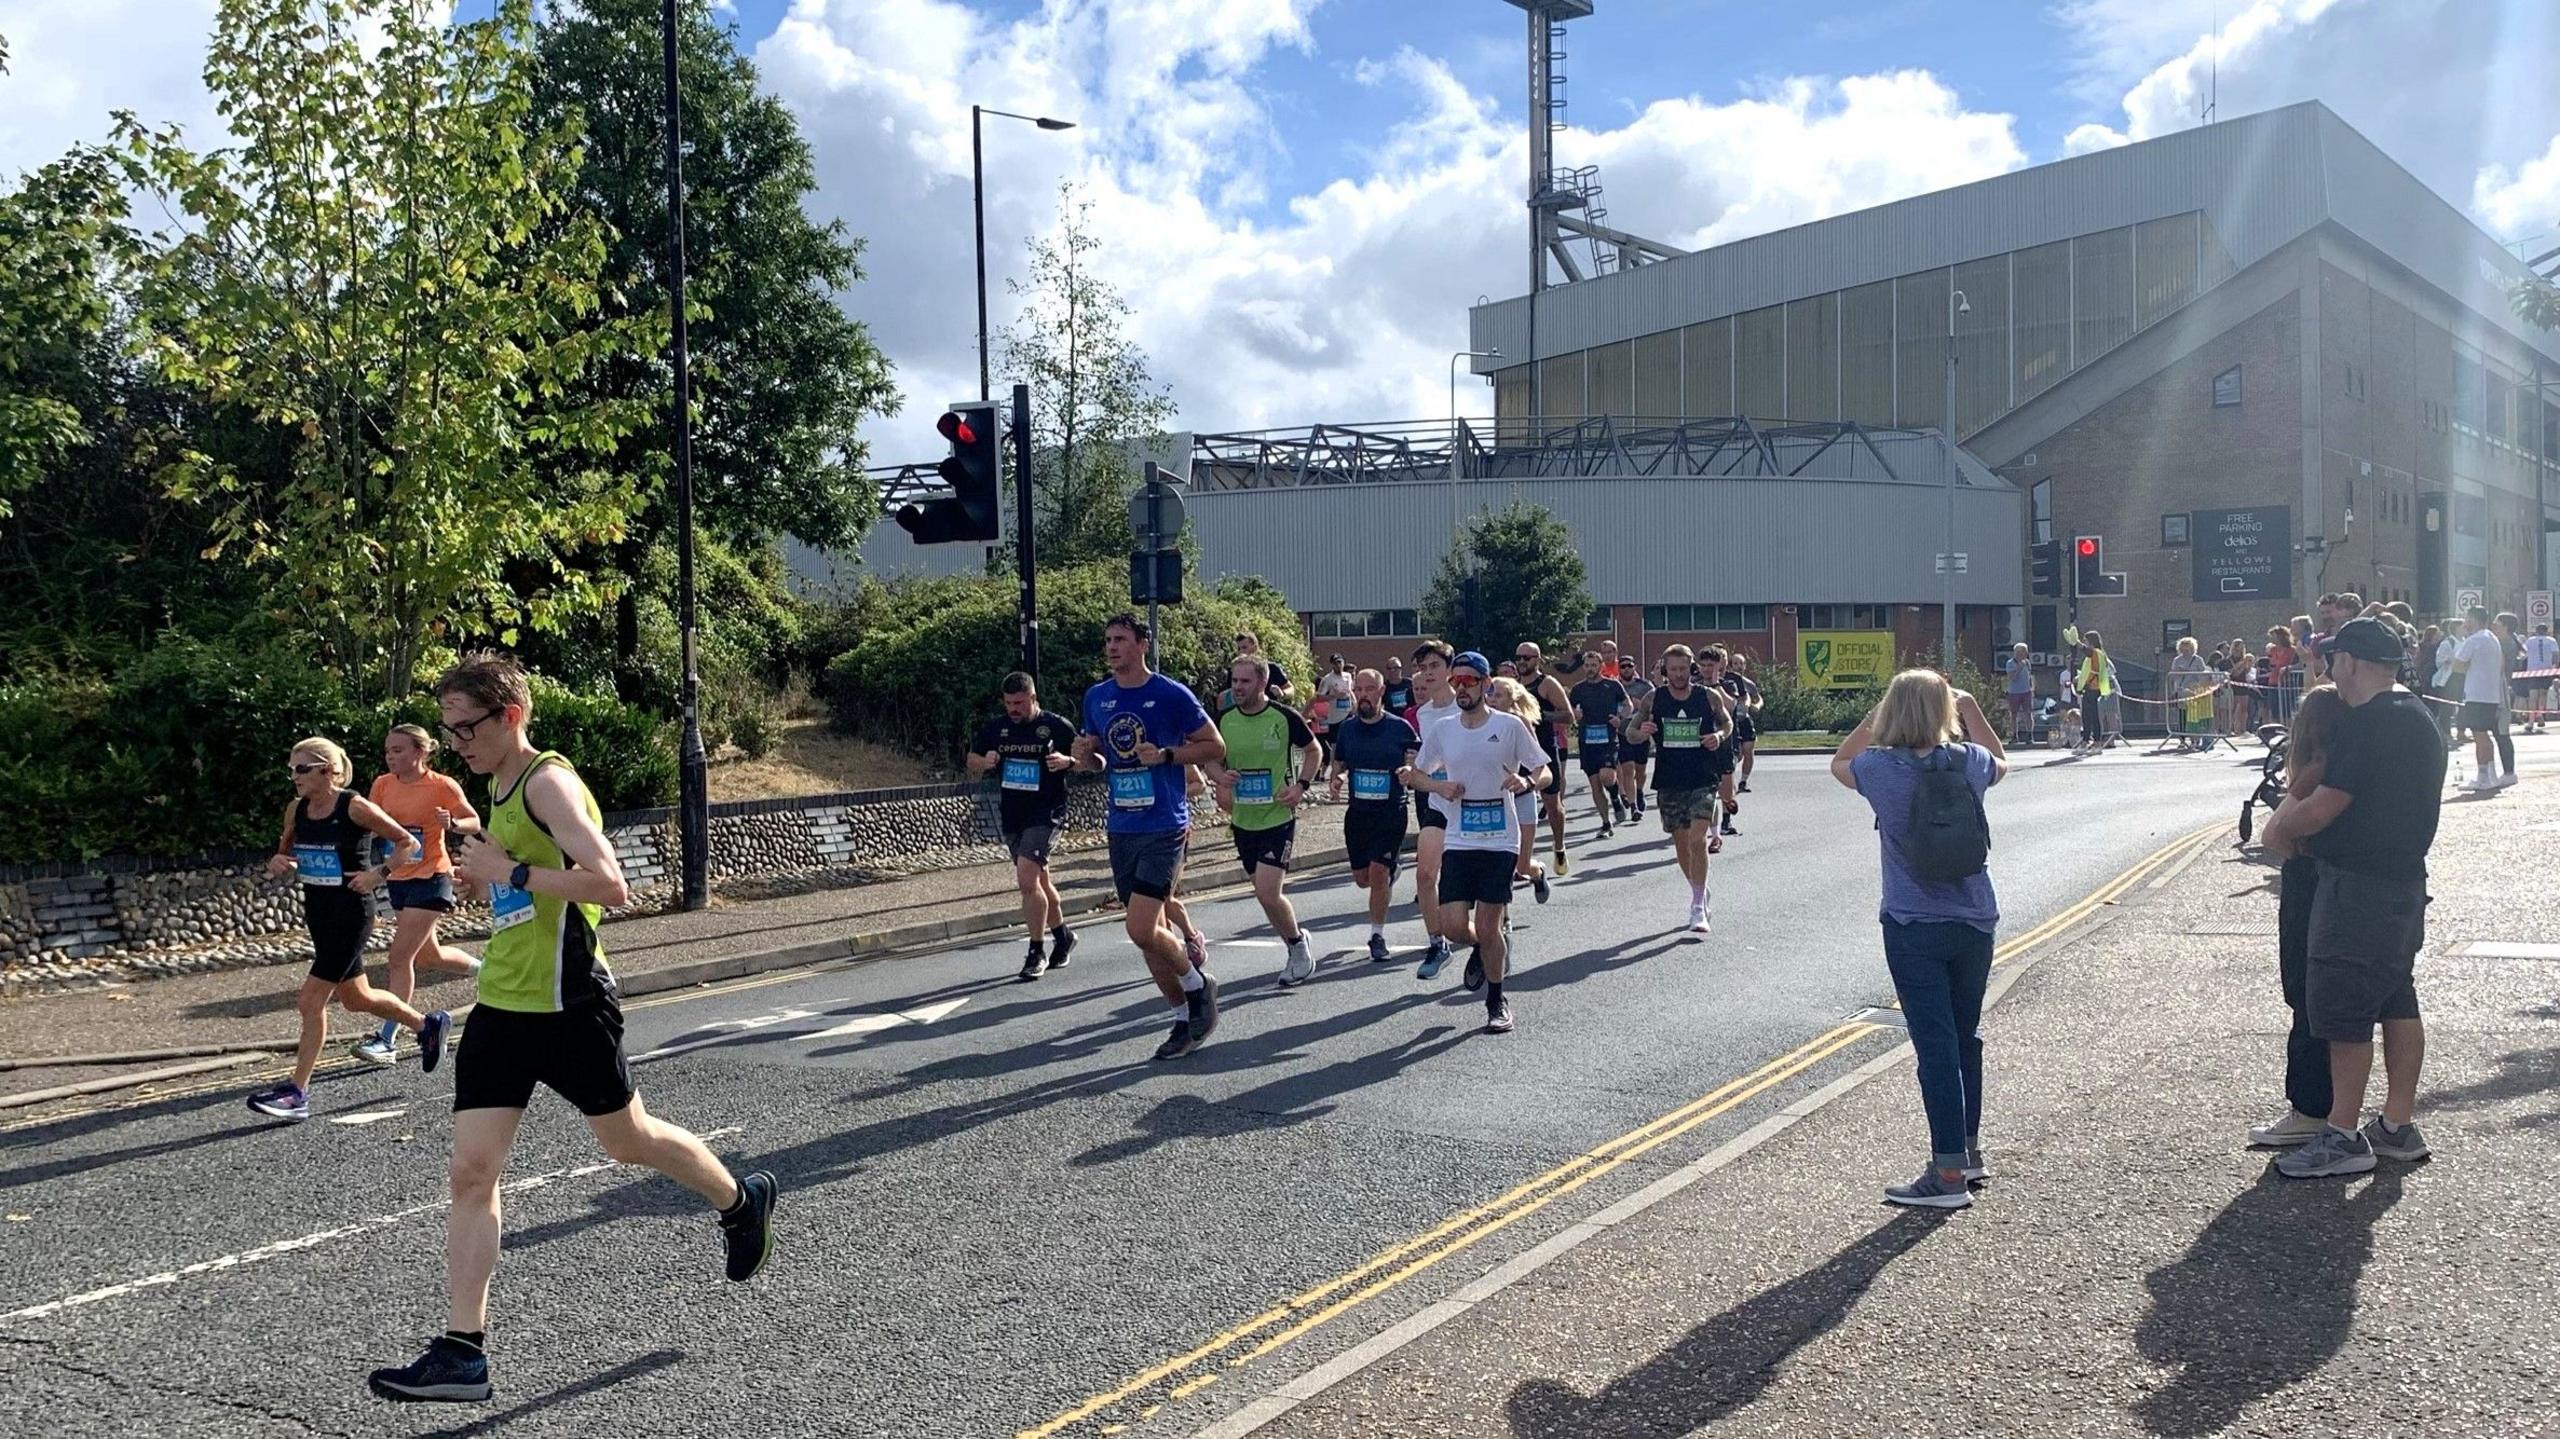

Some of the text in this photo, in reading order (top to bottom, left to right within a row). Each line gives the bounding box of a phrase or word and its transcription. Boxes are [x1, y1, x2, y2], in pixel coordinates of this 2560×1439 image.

[2227, 513, 2254, 523] FREE
[2219, 522, 2263, 533] PARKING
[2211, 556, 2272, 566] YELLOWS
[2211, 566, 2272, 576] RESTAURANTS
[2461, 597, 2478, 609] 20
[1837, 643, 1883, 656] OFFICIAL
[1838, 657, 1873, 671] STORE
[1007, 765, 1035, 778] 2041
